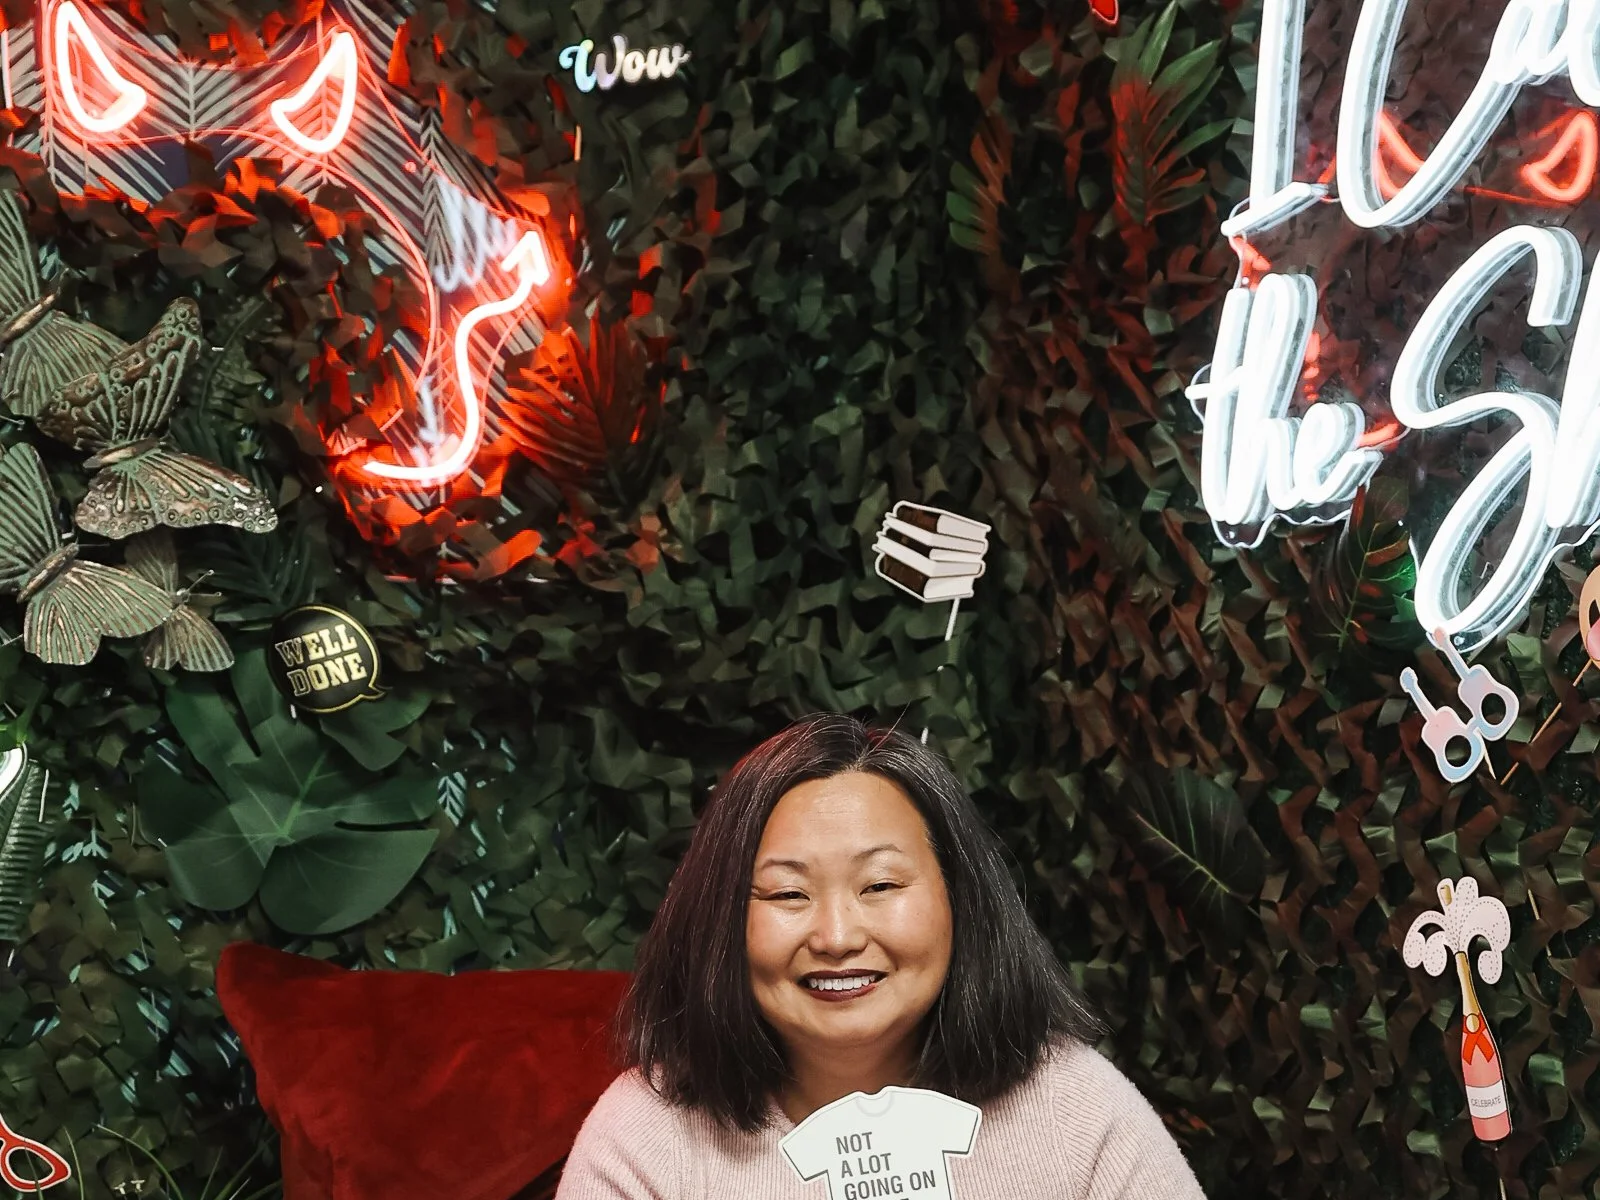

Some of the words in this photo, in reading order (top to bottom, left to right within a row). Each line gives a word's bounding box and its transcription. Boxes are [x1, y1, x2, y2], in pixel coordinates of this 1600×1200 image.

[559, 35, 691, 92] Wow
[1186, 273, 1384, 525] the
[275, 624, 358, 667] WELL
[287, 652, 368, 697] DONE
[1471, 1095, 1502, 1107] CELEBRATE
[836, 1131, 873, 1154] NOT
[841, 1160, 853, 1178] A
[858, 1153, 891, 1175] LOT
[909, 1170, 936, 1191] ON
